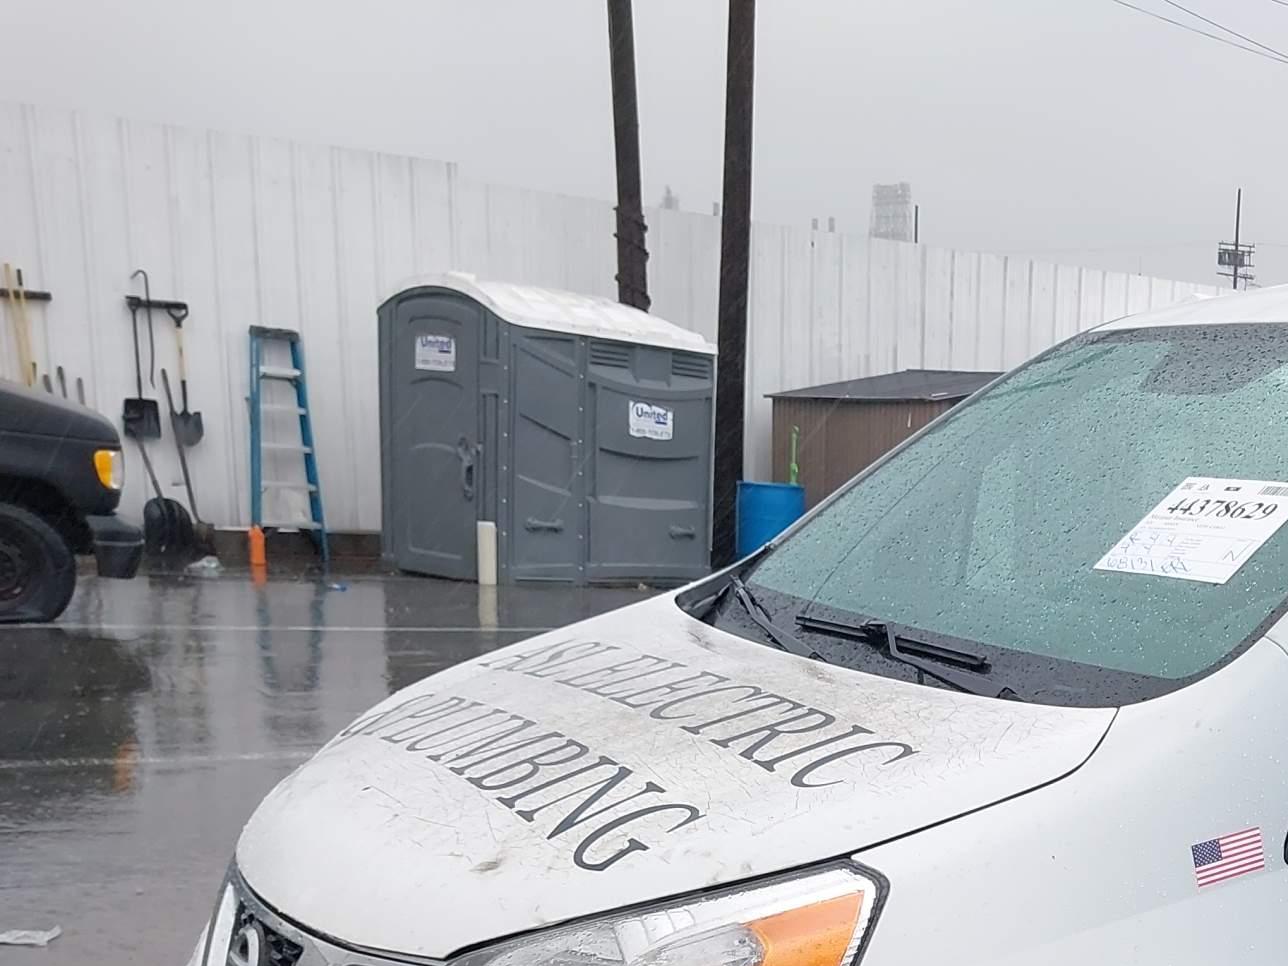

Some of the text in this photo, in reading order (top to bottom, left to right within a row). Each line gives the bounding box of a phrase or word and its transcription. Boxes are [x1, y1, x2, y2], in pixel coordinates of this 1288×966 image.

[1167, 498, 1279, 520] 44378629
[362, 696, 707, 872] PLUMBING
[478, 638, 921, 788] ASL ELECTRIC
